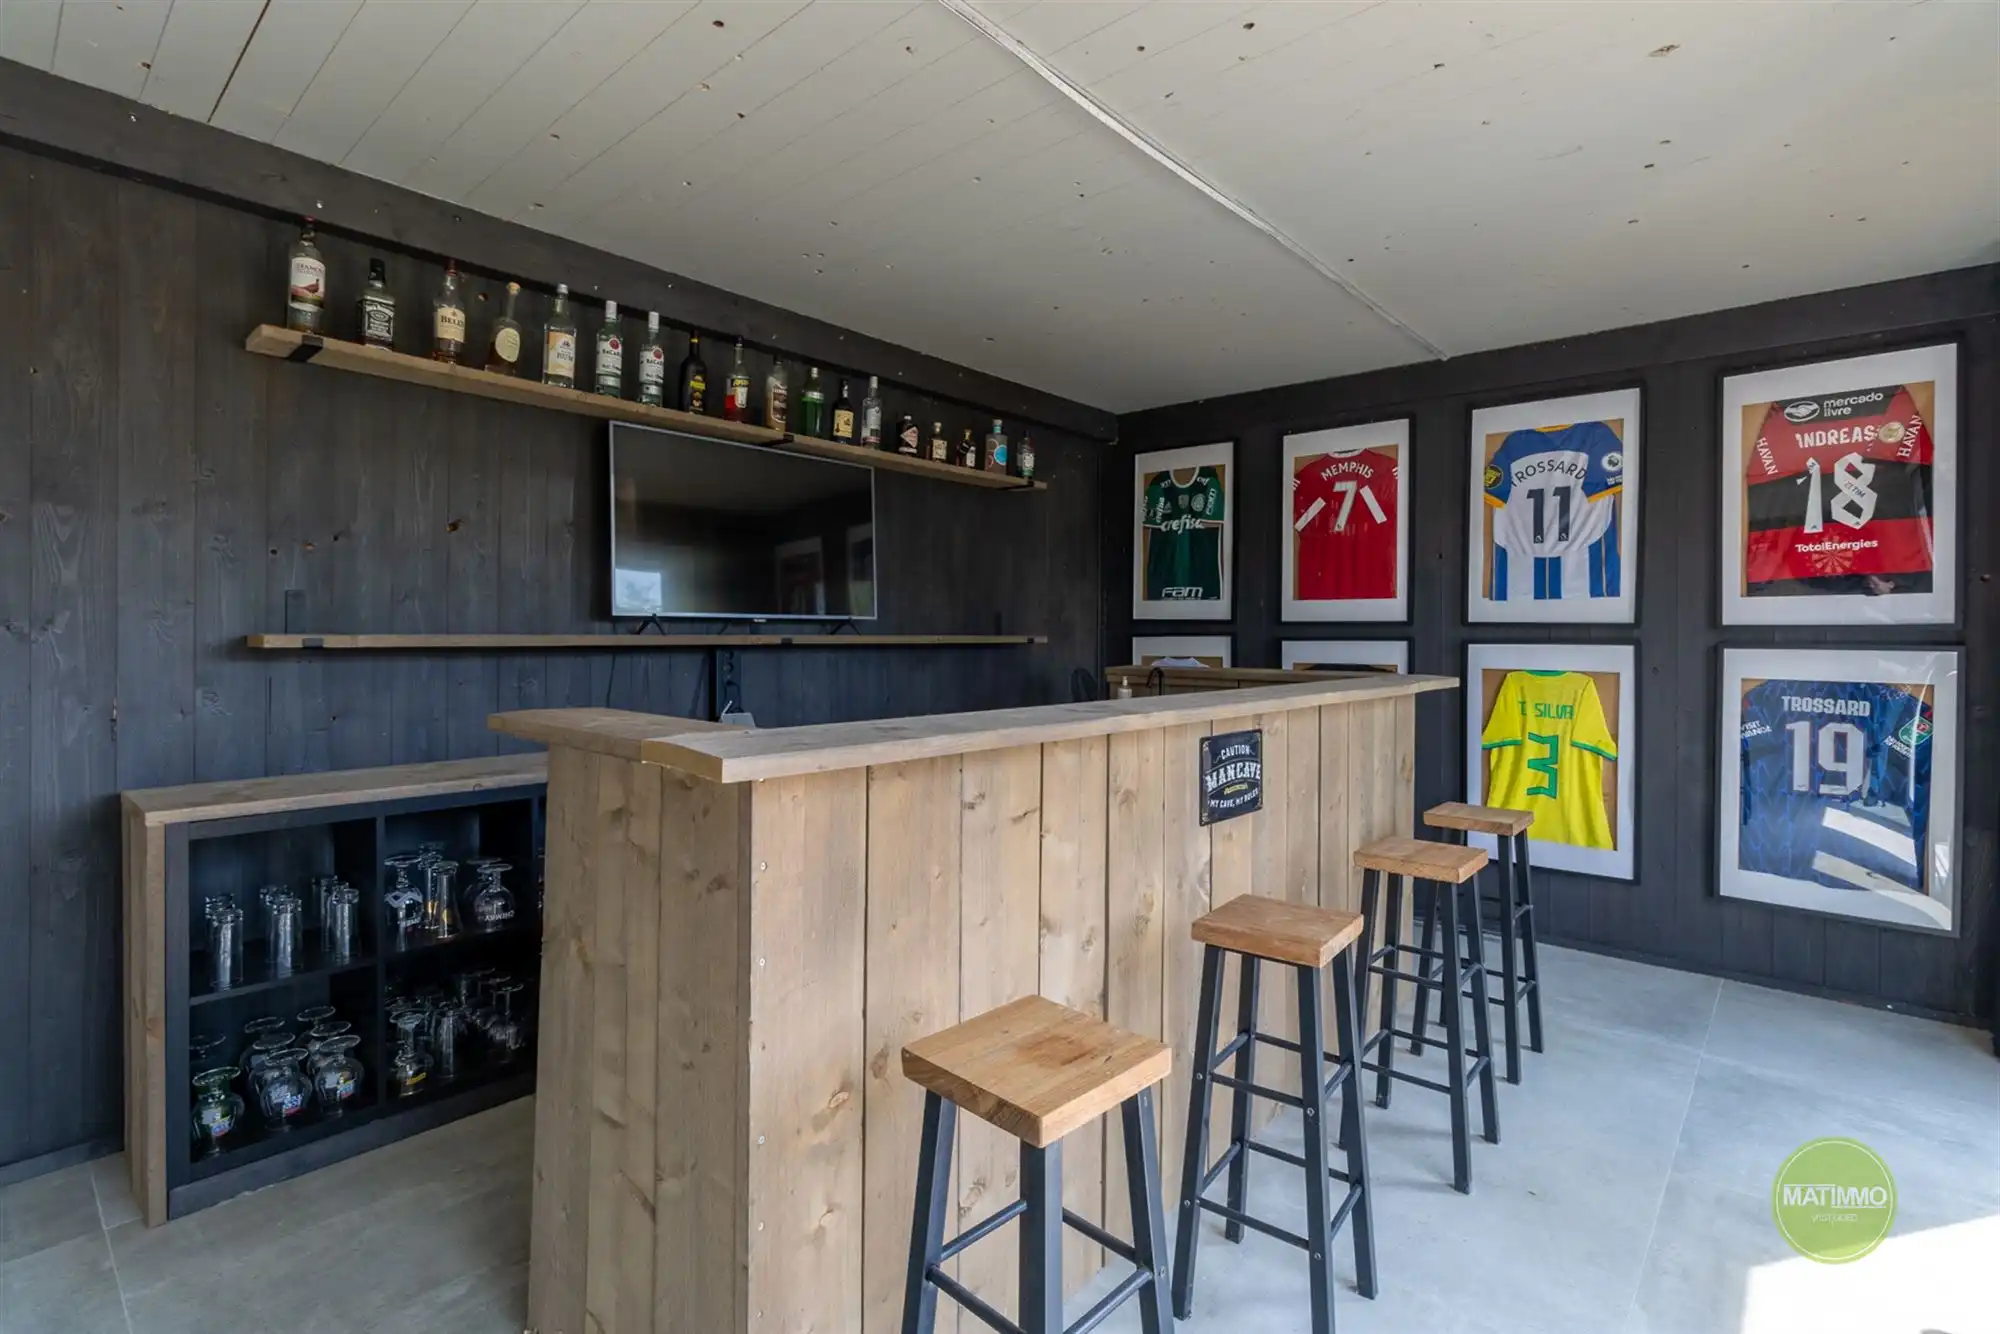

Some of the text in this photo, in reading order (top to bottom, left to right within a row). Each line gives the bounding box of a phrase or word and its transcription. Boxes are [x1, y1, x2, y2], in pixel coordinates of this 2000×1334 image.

[1823, 392, 1884, 408] mercado
[1824, 407, 1852, 417] livre
[1896, 414, 1922, 458] HAVAN
[1321, 461, 1374, 481] MEMPHIS
[1756, 436, 1778, 476] HAVAN
[1333, 480, 1357, 532] 7
[1796, 452, 1878, 533] 18
[1526, 486, 1571, 544] 11
[1795, 539, 1878, 553] TotalEnergies
[1781, 696, 1871, 717] TROSSARD
[1220, 744, 1250, 759] CAUTION
[1527, 731, 1559, 800] 3
[1785, 721, 1864, 795] 19
[1205, 761, 1261, 792] MANCAVE
